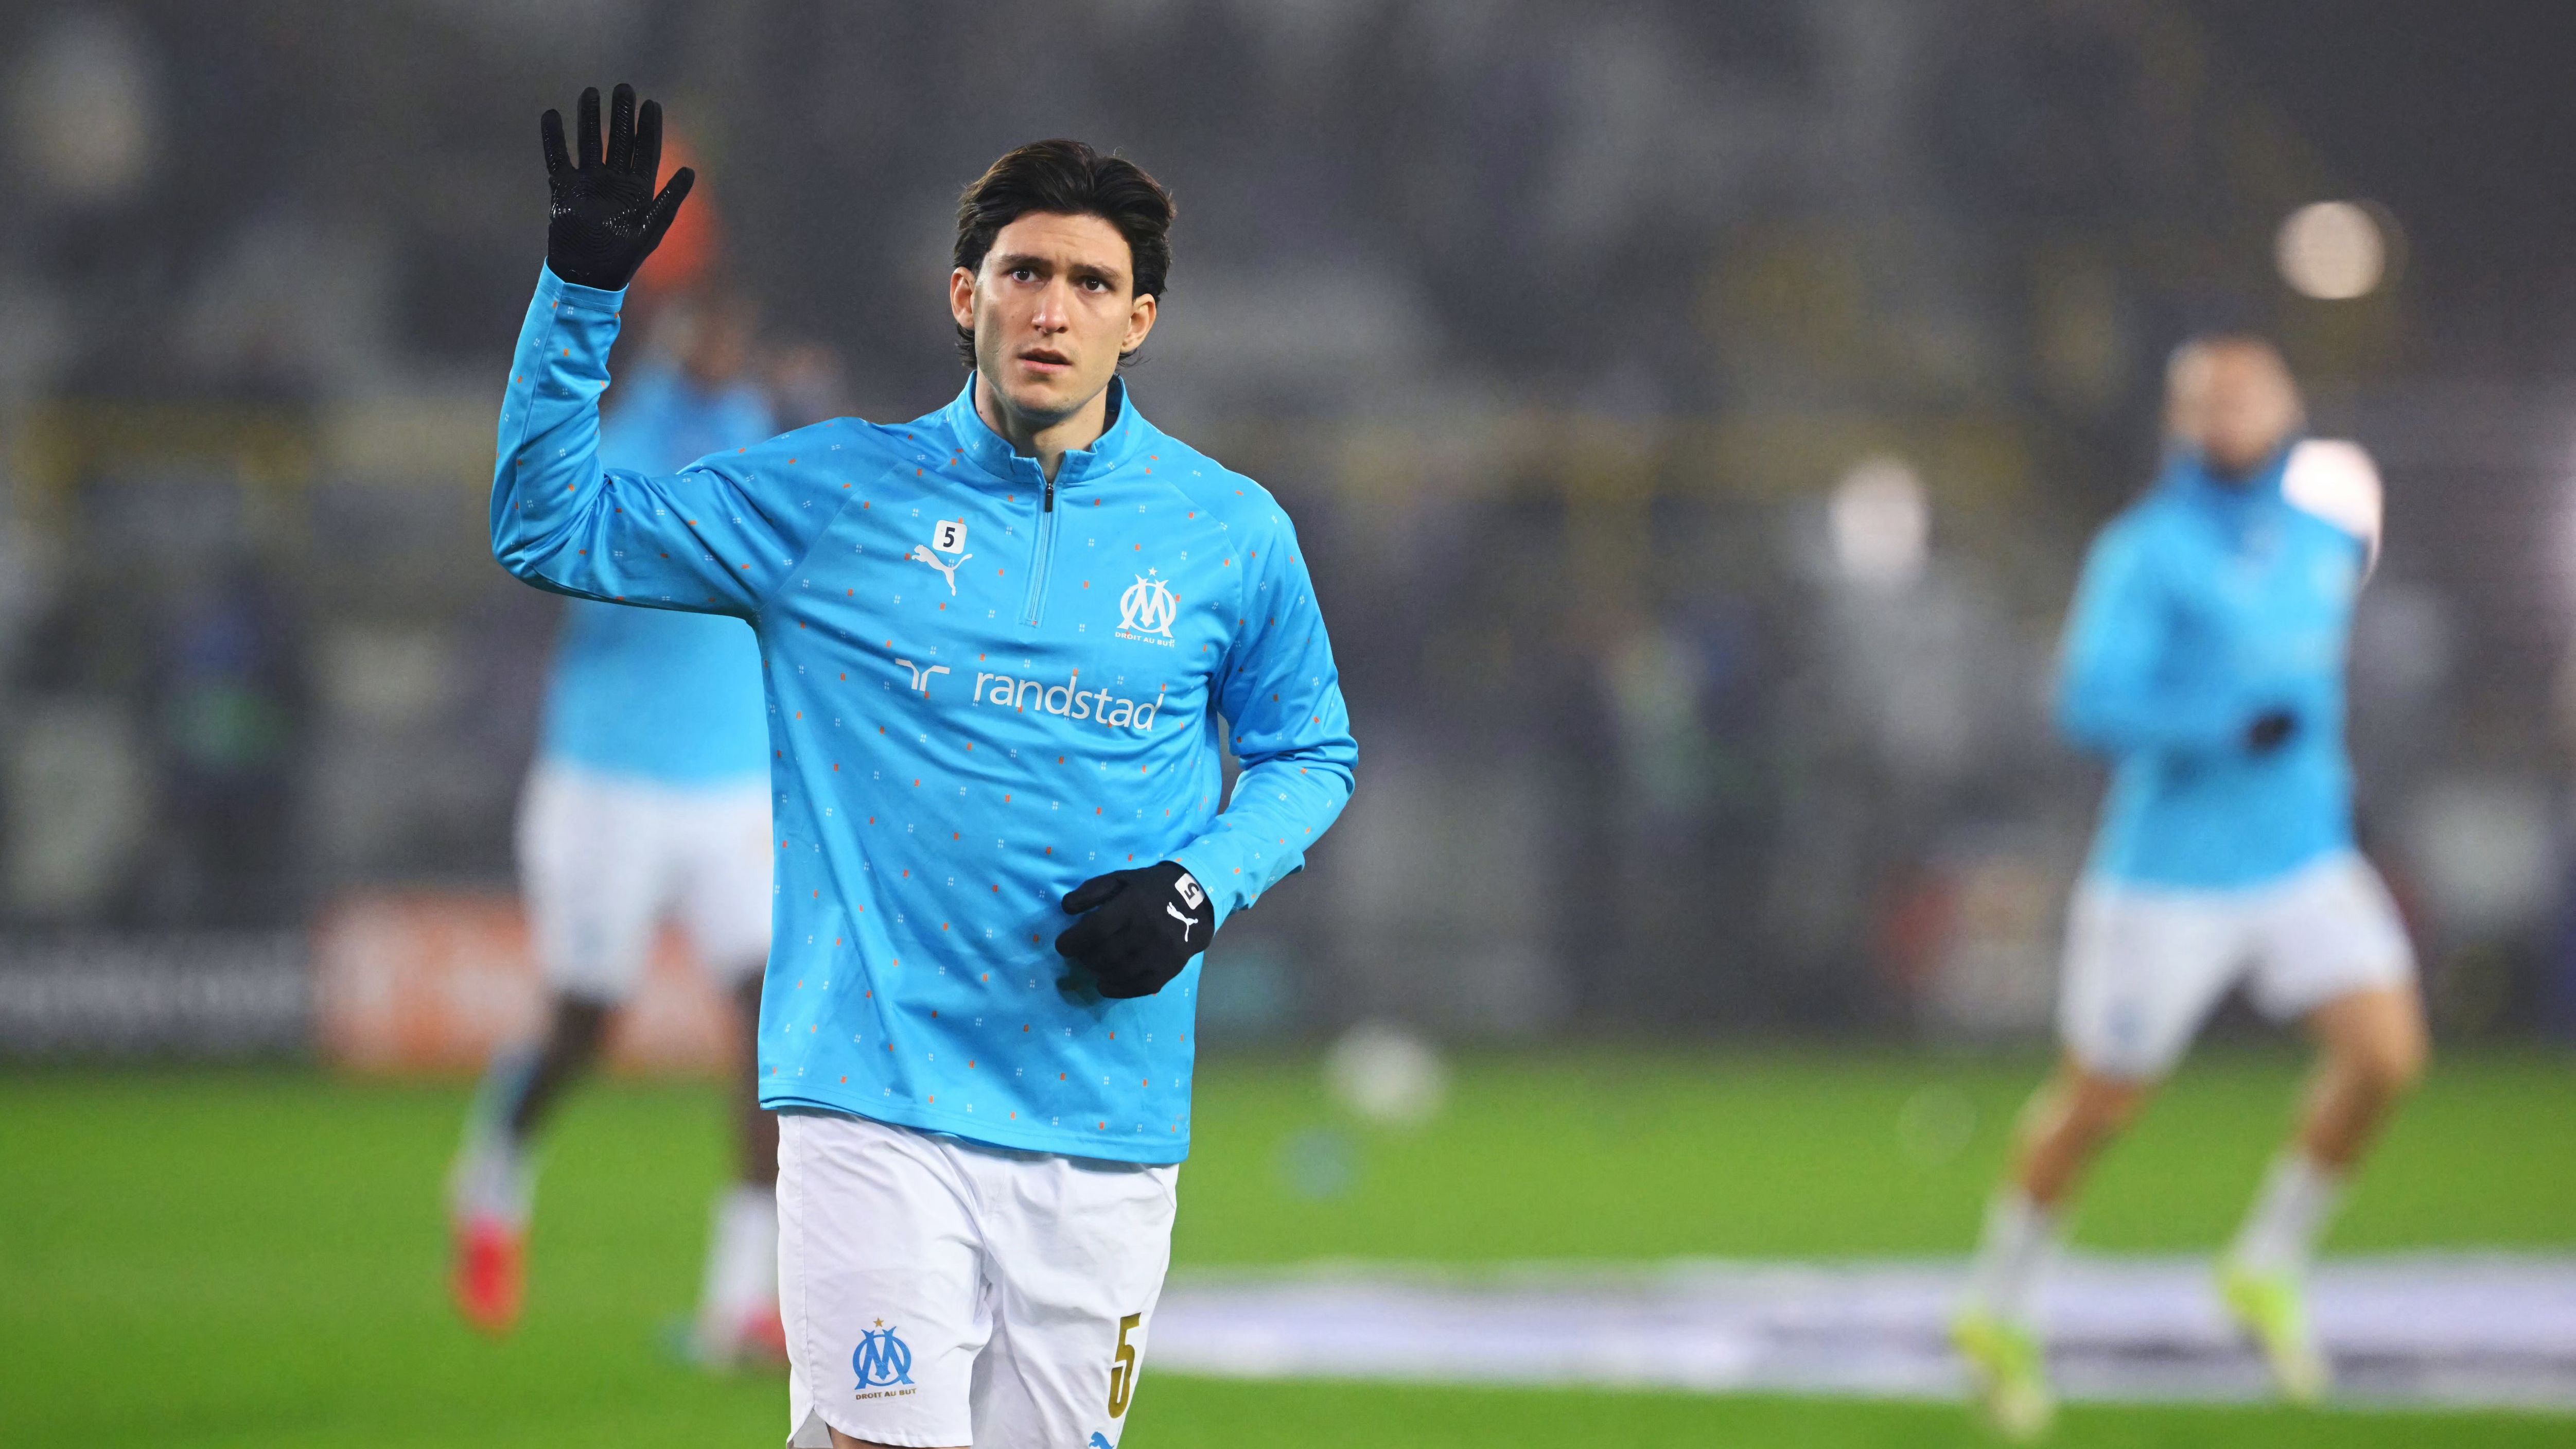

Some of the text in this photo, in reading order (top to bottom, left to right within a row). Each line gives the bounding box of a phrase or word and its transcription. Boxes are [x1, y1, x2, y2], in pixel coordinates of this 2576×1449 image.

[943, 526, 956, 548] 5
[1115, 631, 1142, 641] DROIT
[1156, 639, 1173, 648] BUT
[973, 672, 1164, 731] randstad
[1184, 882, 1199, 900] 5
[1108, 1312, 1142, 1419] 5
[855, 1391, 883, 1400] DROIT
[899, 1388, 917, 1396] BUT
